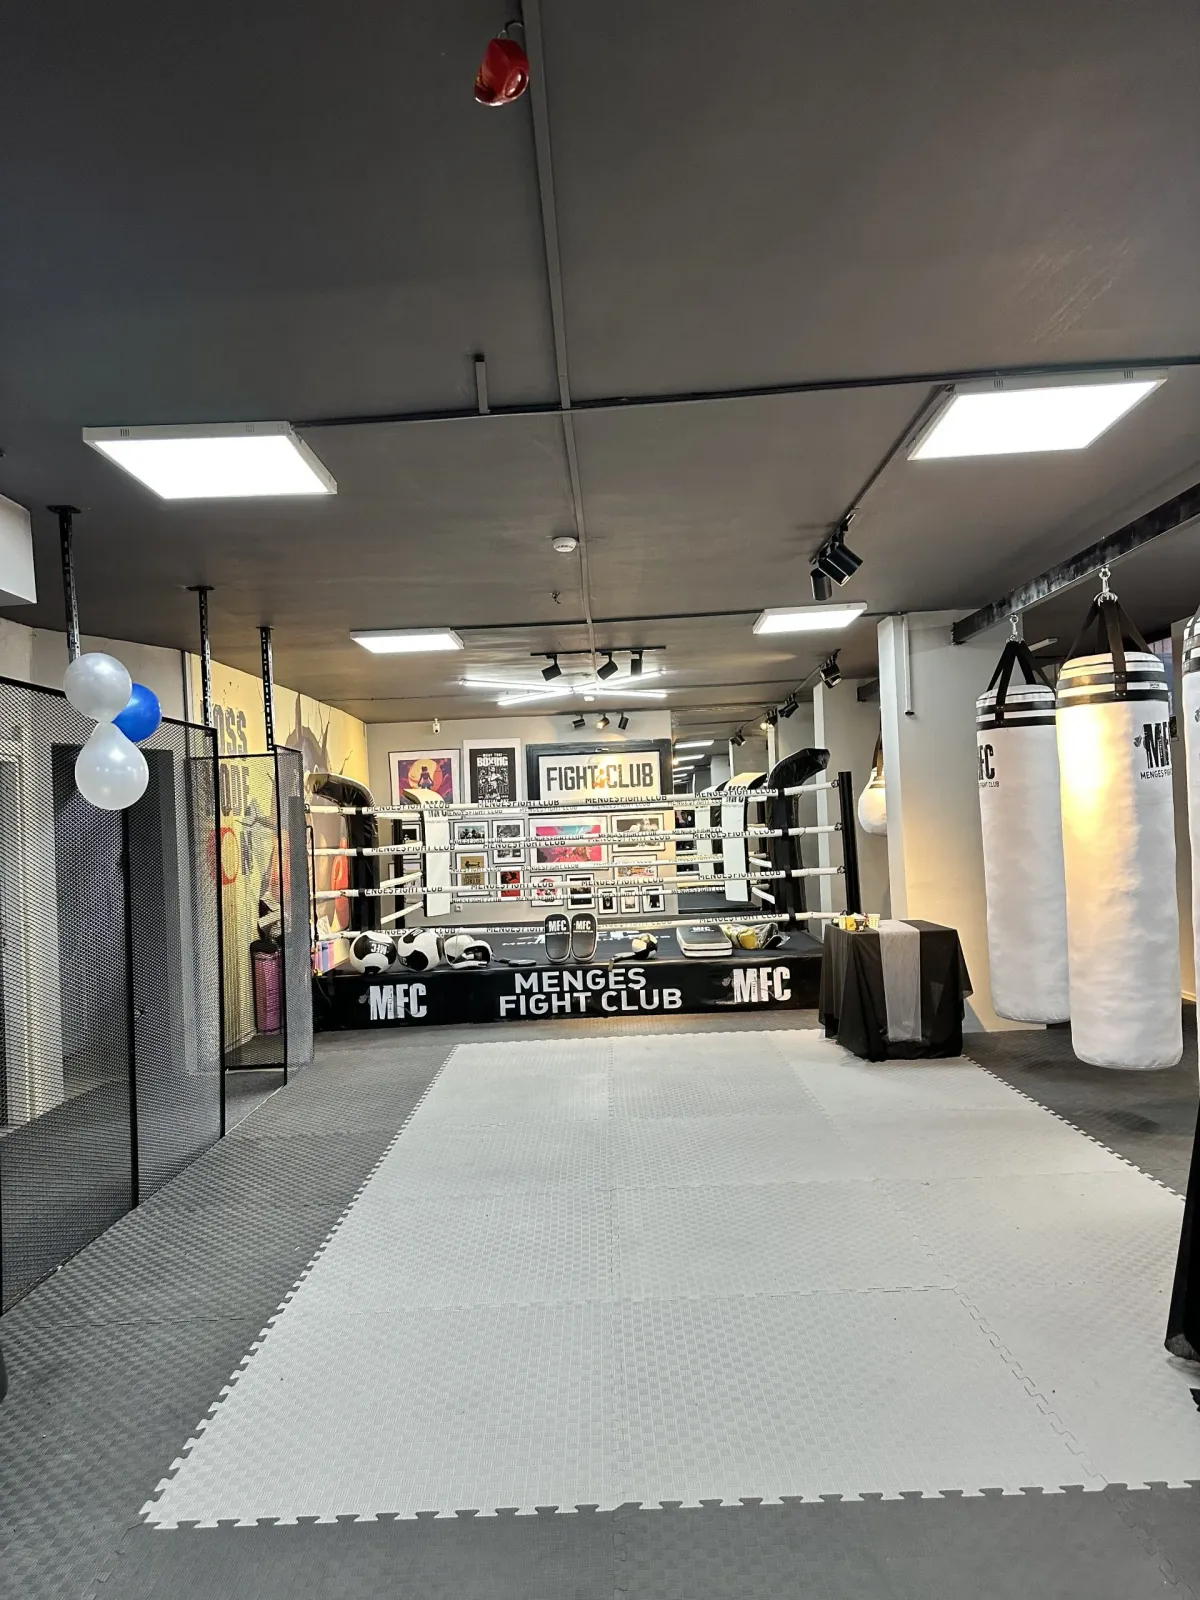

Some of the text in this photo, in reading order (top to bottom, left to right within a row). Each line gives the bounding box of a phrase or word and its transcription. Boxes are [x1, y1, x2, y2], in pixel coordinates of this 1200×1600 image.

[200, 700, 248, 757] OSS
[1143, 721, 1171, 769] MF
[477, 756, 508, 767] BOXING
[978, 744, 995, 780] FC
[1140, 770, 1164, 780] MENGES
[546, 762, 654, 791] FIGHT CLUB
[548, 920, 566, 932] MFC
[576, 920, 591, 930] MFC
[515, 967, 646, 994] MENGES
[733, 966, 791, 1003] MFC
[369, 982, 427, 1021] MFC
[500, 988, 683, 1017] FIGHT CLUB
